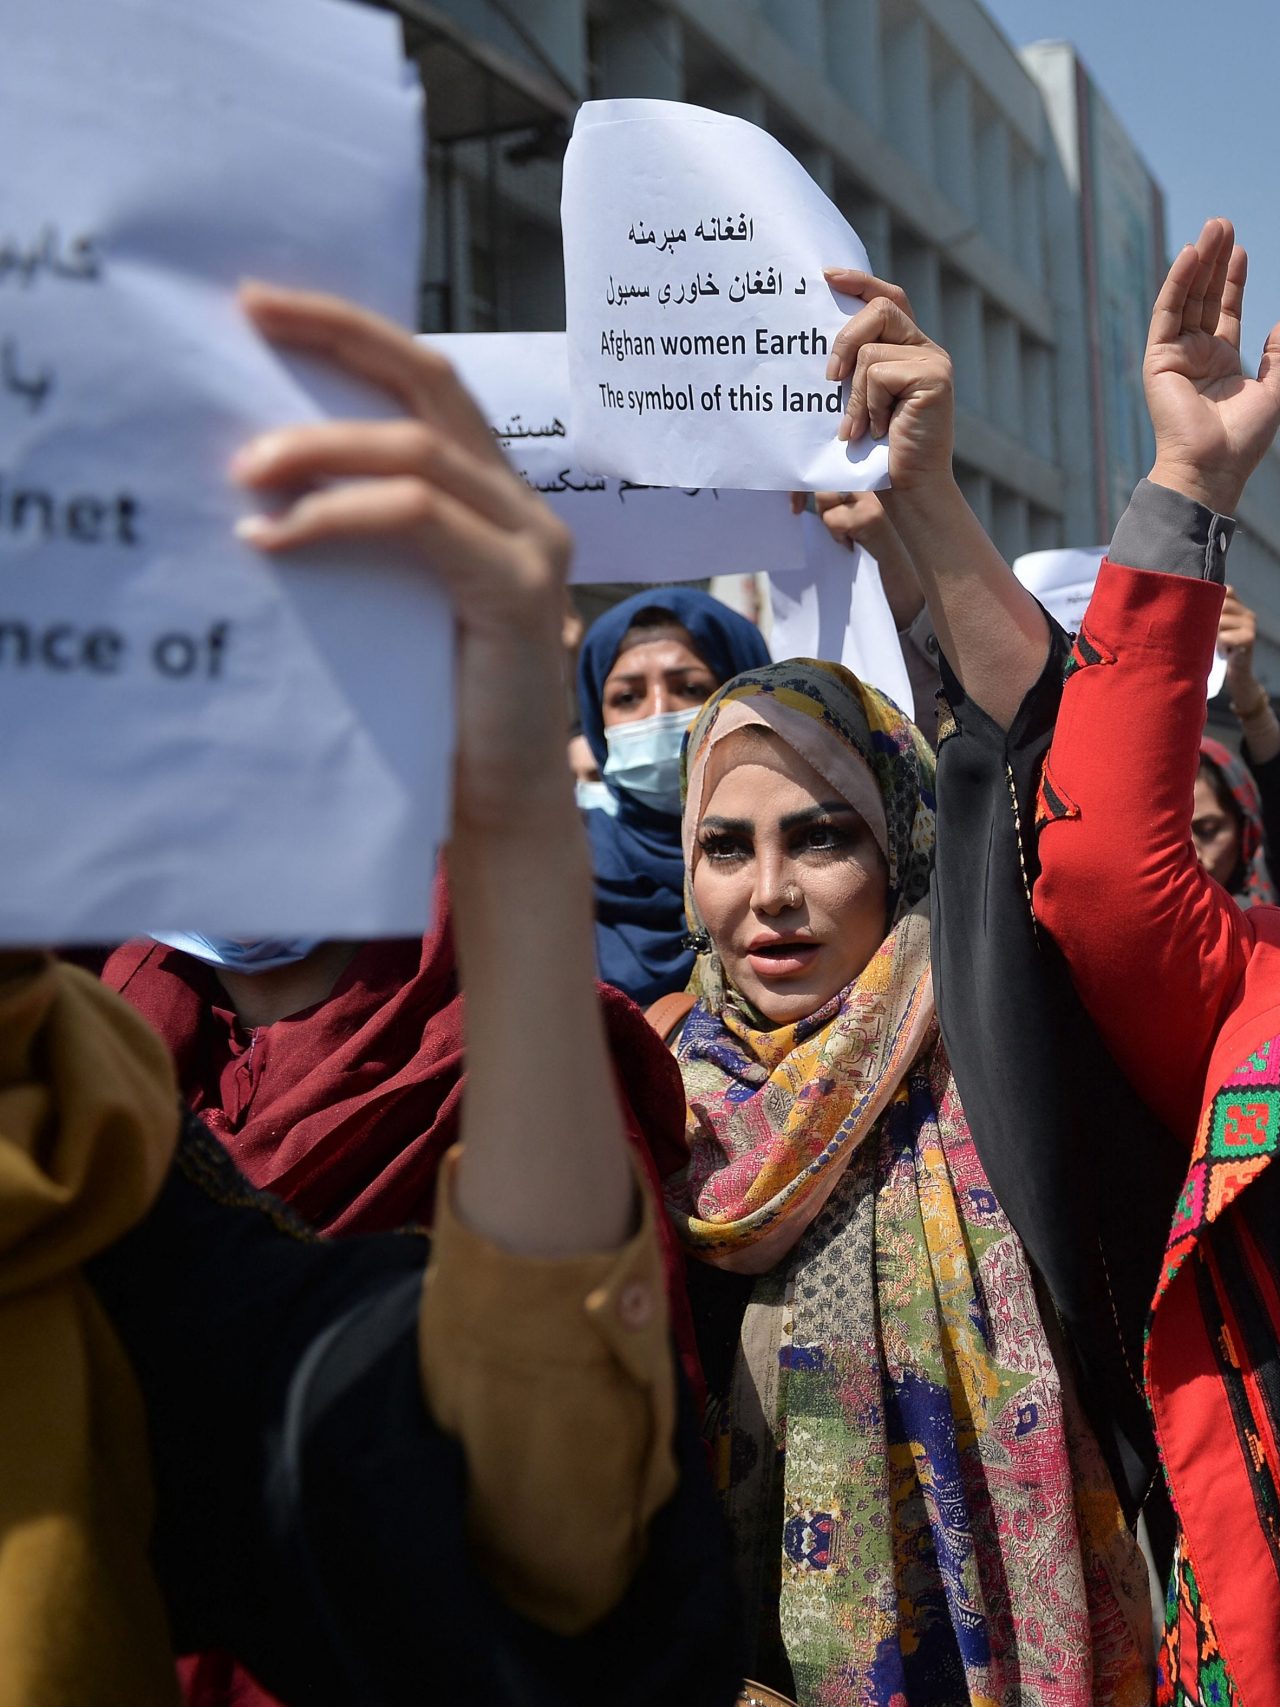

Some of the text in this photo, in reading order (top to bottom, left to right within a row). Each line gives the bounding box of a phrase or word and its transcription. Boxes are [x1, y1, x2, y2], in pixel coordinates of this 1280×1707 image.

[694, 212, 755, 242] افغانه
[606, 274, 650, 306] سمبول
[728, 267, 783, 303] افغان
[794, 276, 807, 295] د
[600, 327, 828, 361] Afghan women Earth
[599, 382, 843, 416] The symbol of this land
[0, 488, 141, 548] net
[0, 616, 233, 681] nce of
